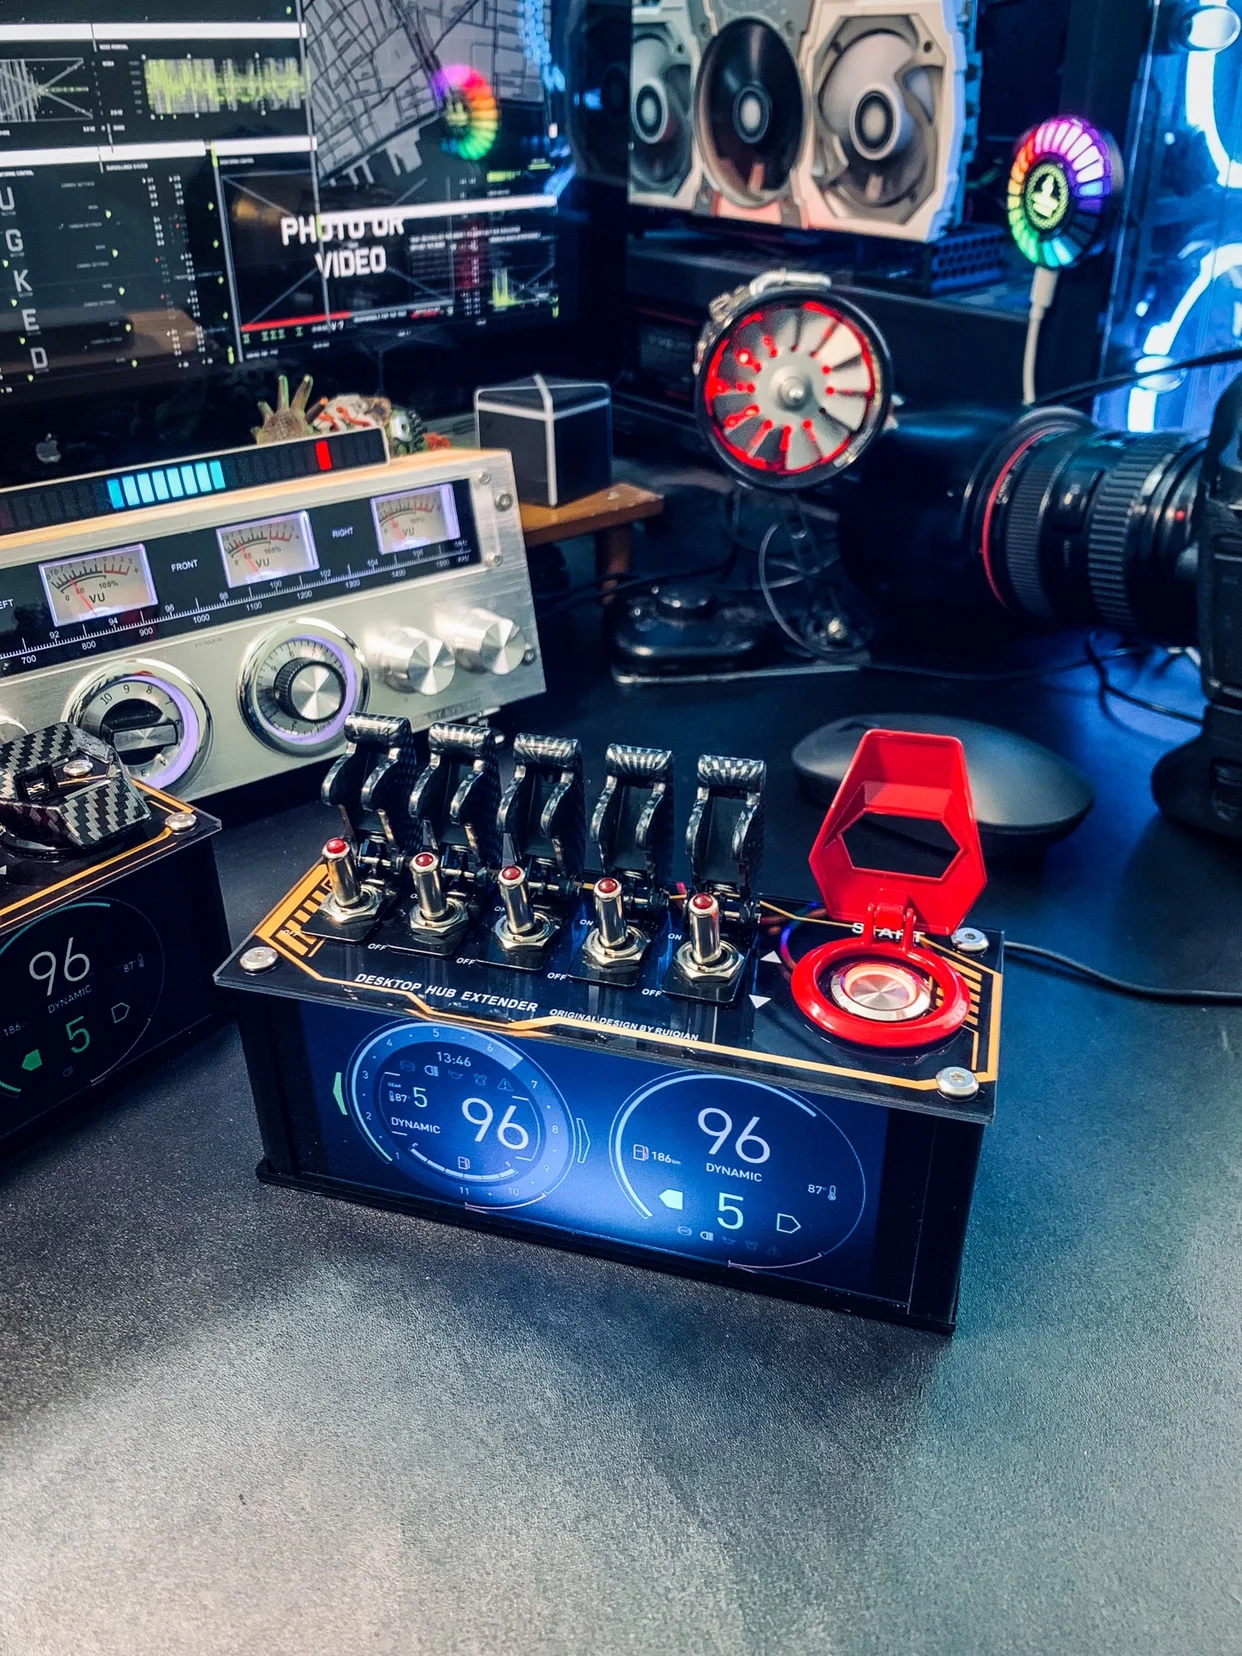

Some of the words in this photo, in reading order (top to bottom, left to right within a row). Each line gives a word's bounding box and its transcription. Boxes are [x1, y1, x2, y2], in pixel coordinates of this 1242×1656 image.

[5, 229, 24, 252] G
[315, 245, 387, 280] VIDEO
[13, 269, 33, 293] K
[22, 309, 40, 331] E
[30, 348, 49, 370] D
[332, 526, 354, 539] RIGHT
[402, 527, 415, 537] VU
[171, 559, 198, 573] FRONT
[255, 558, 270, 568] VU
[89, 592, 106, 604] VU
[49, 630, 60, 640] 92
[108, 617, 119, 627] 94
[270, 580, 283, 589] 100
[21, 654, 37, 665] 700
[81, 640, 97, 651] 800
[139, 627, 154, 637] 900
[193, 614, 211, 624] 1000
[246, 601, 263, 612] 1100
[297, 590, 313, 600] 1200
[100, 692, 113, 706] 10
[123, 684, 130, 694] 9
[146, 685, 153, 695] 8
[668, 933, 682, 941] ON
[852, 922, 926, 943] SART
[367, 942, 387, 952] OFF
[29, 937, 91, 997] 96
[456, 957, 476, 966] OFF
[547, 972, 567, 981] OFF
[48, 984, 92, 1014] DYNAMIC
[354, 973, 421, 992] DESKTOP
[425, 984, 457, 998] HUB
[461, 991, 538, 1012] EXTENDER
[641, 988, 662, 998] OFF
[550, 1008, 598, 1024] ORIGINAL
[599, 1018, 638, 1032] DESIGN
[639, 1024, 654, 1033] BY
[66, 1016, 90, 1053] 5
[433, 1028, 440, 1038] 5
[386, 1038, 393, 1047] 4
[487, 1043, 494, 1052] 6
[437, 1051, 472, 1068] 13:46
[362, 1070, 369, 1079] 3
[531, 1080, 538, 1089] 7
[413, 1086, 428, 1108] 5
[365, 1111, 372, 1121] 2
[461, 1097, 529, 1150] 96
[391, 1116, 441, 1135] DYNAMIC
[552, 1125, 559, 1134] 8
[698, 1107, 771, 1164] 96
[543, 1164, 550, 1173] 9
[706, 1163, 763, 1183] DYNAMIC
[459, 1186, 469, 1196] 11
[508, 1187, 520, 1197] 10
[717, 1192, 744, 1230] 5
